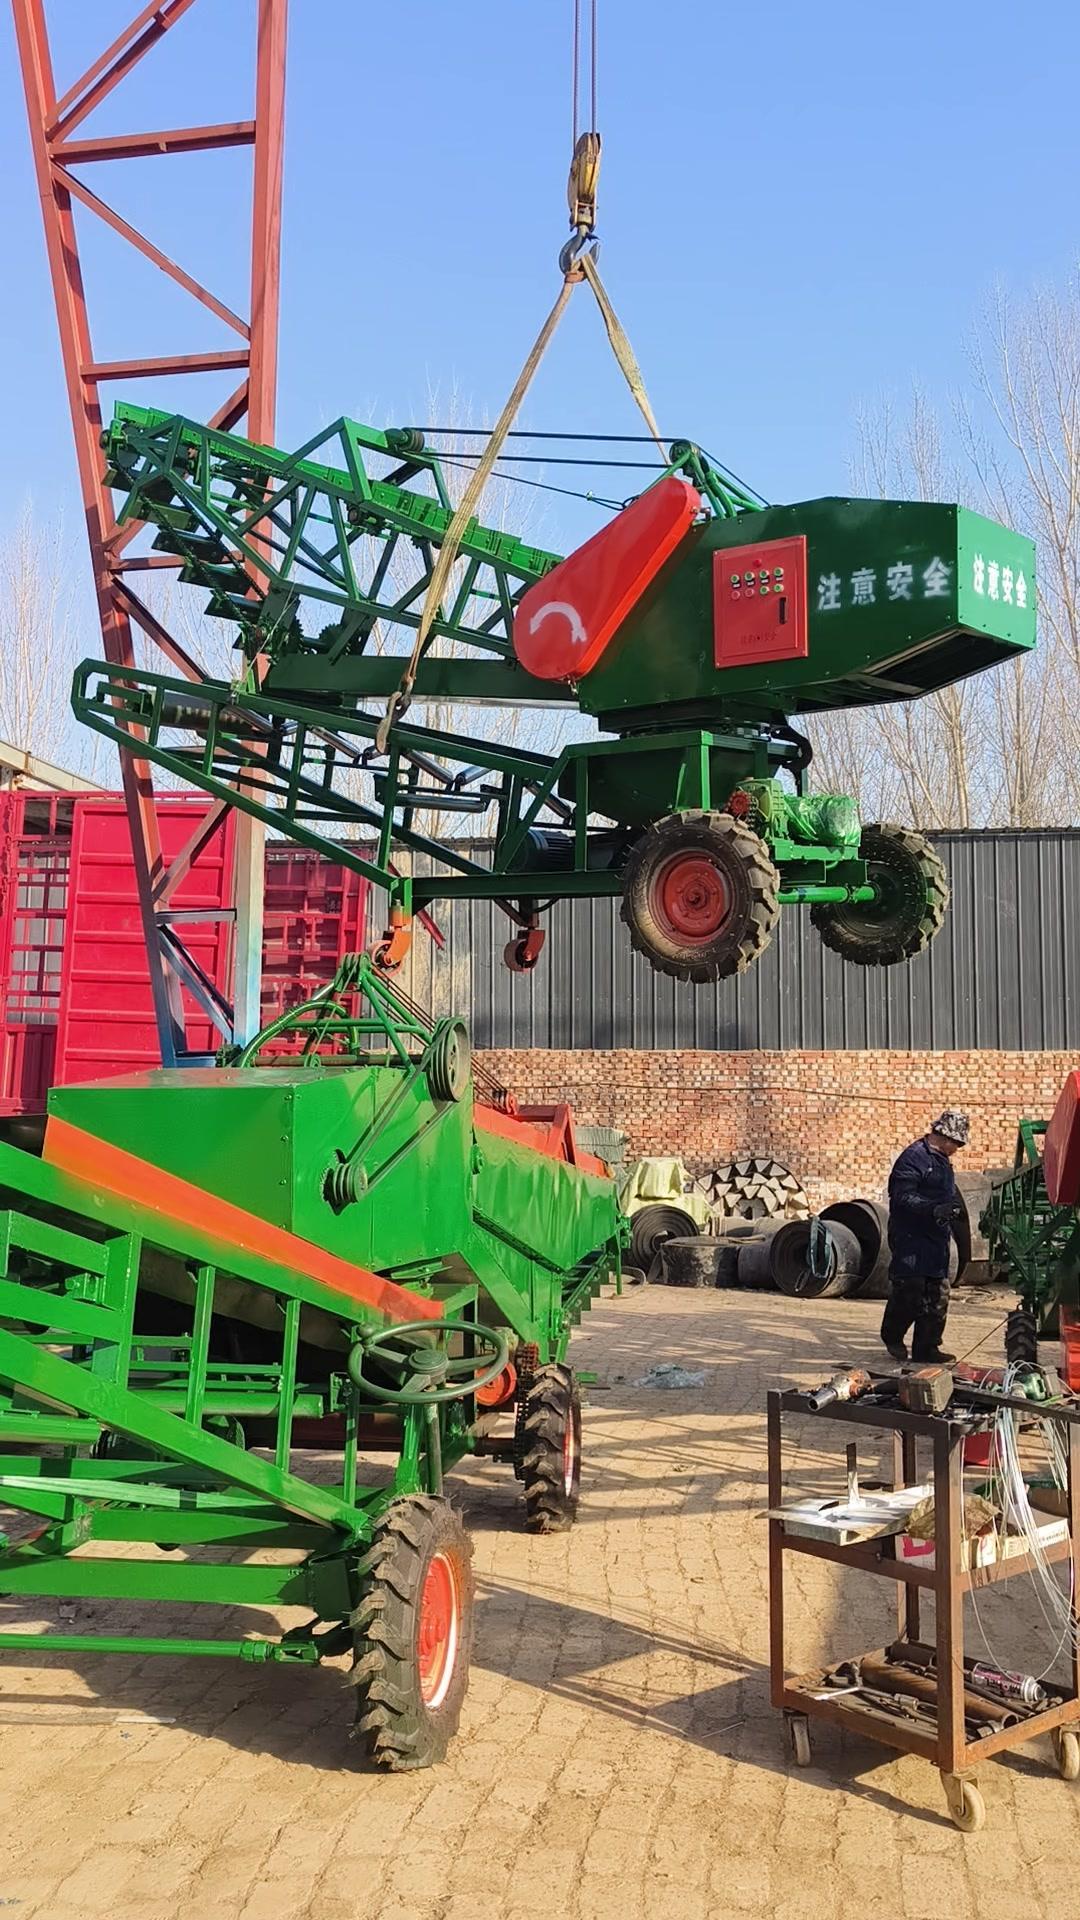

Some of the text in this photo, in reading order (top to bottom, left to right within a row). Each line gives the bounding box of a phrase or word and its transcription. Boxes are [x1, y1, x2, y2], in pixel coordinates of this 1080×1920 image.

[817, 556, 951, 610] 注意安全
[973, 552, 1027, 608] 注意安全
